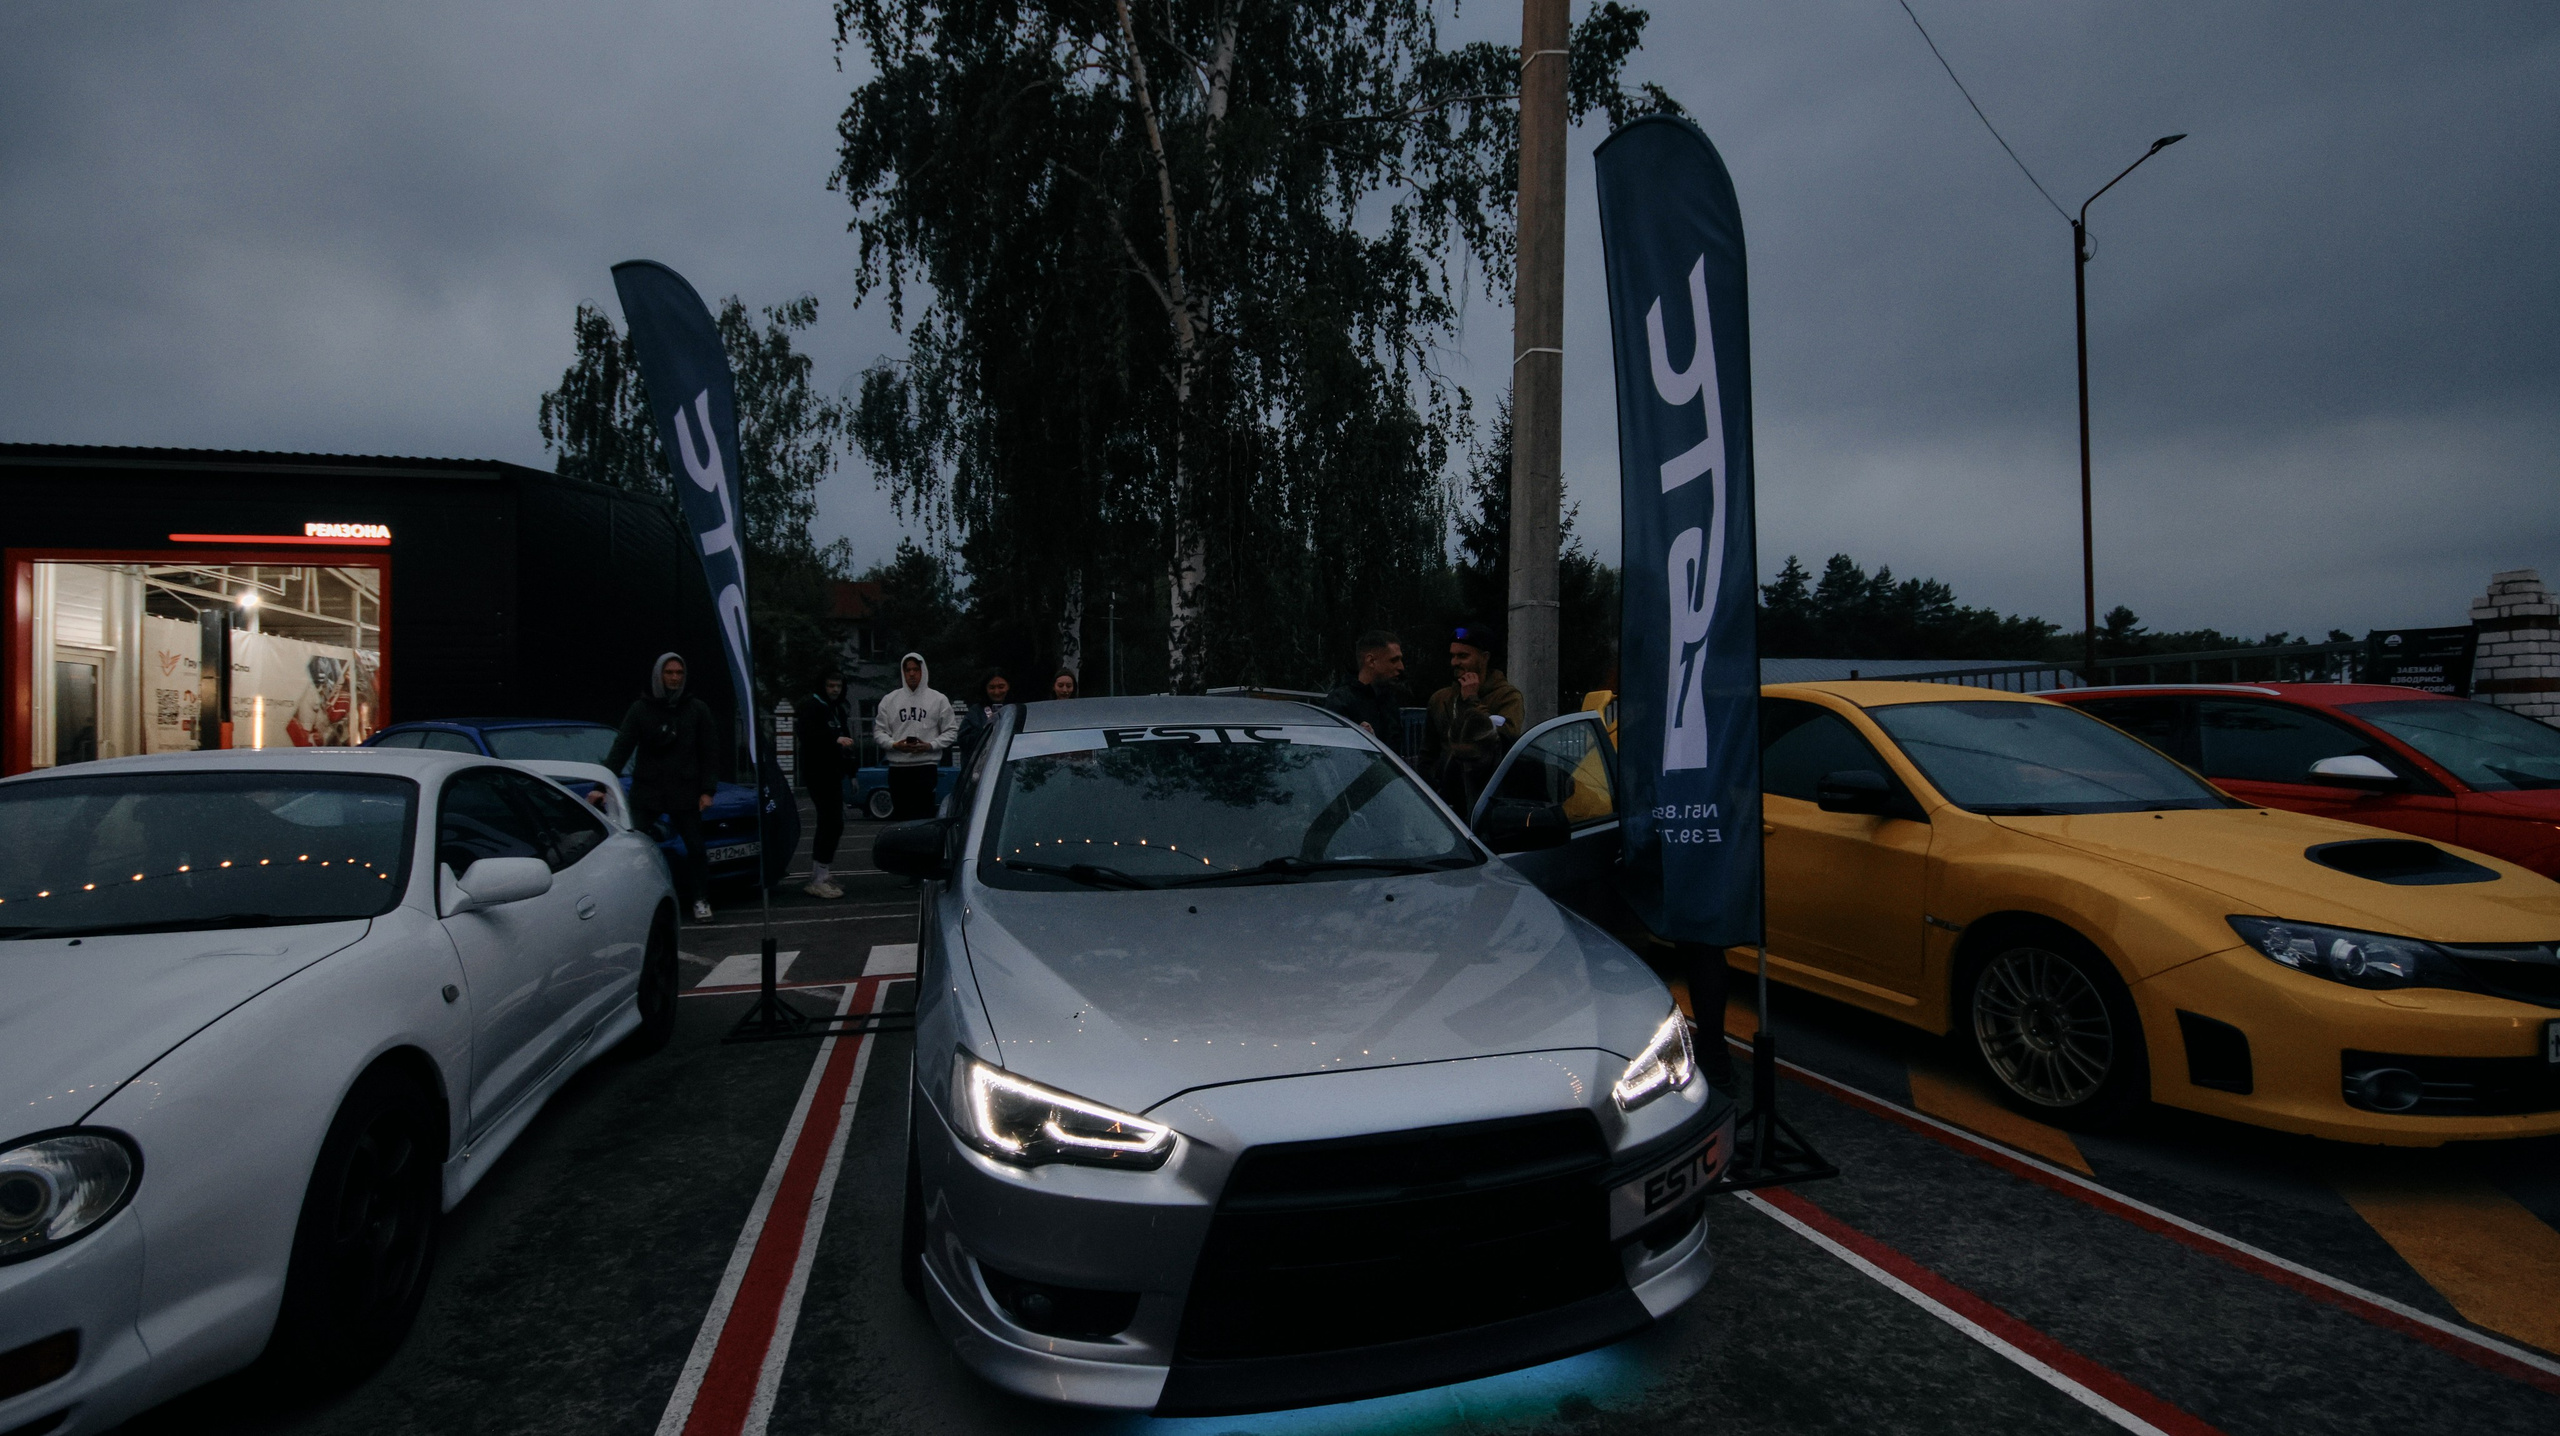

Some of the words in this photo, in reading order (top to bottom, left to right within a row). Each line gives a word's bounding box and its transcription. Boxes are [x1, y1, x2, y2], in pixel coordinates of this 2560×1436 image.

[304, 523, 391, 538] РЕМЗОНА
[899, 707, 927, 722] GAP
[1103, 727, 1291, 749] ESTC
[1645, 1135, 1717, 1217] ESTC
